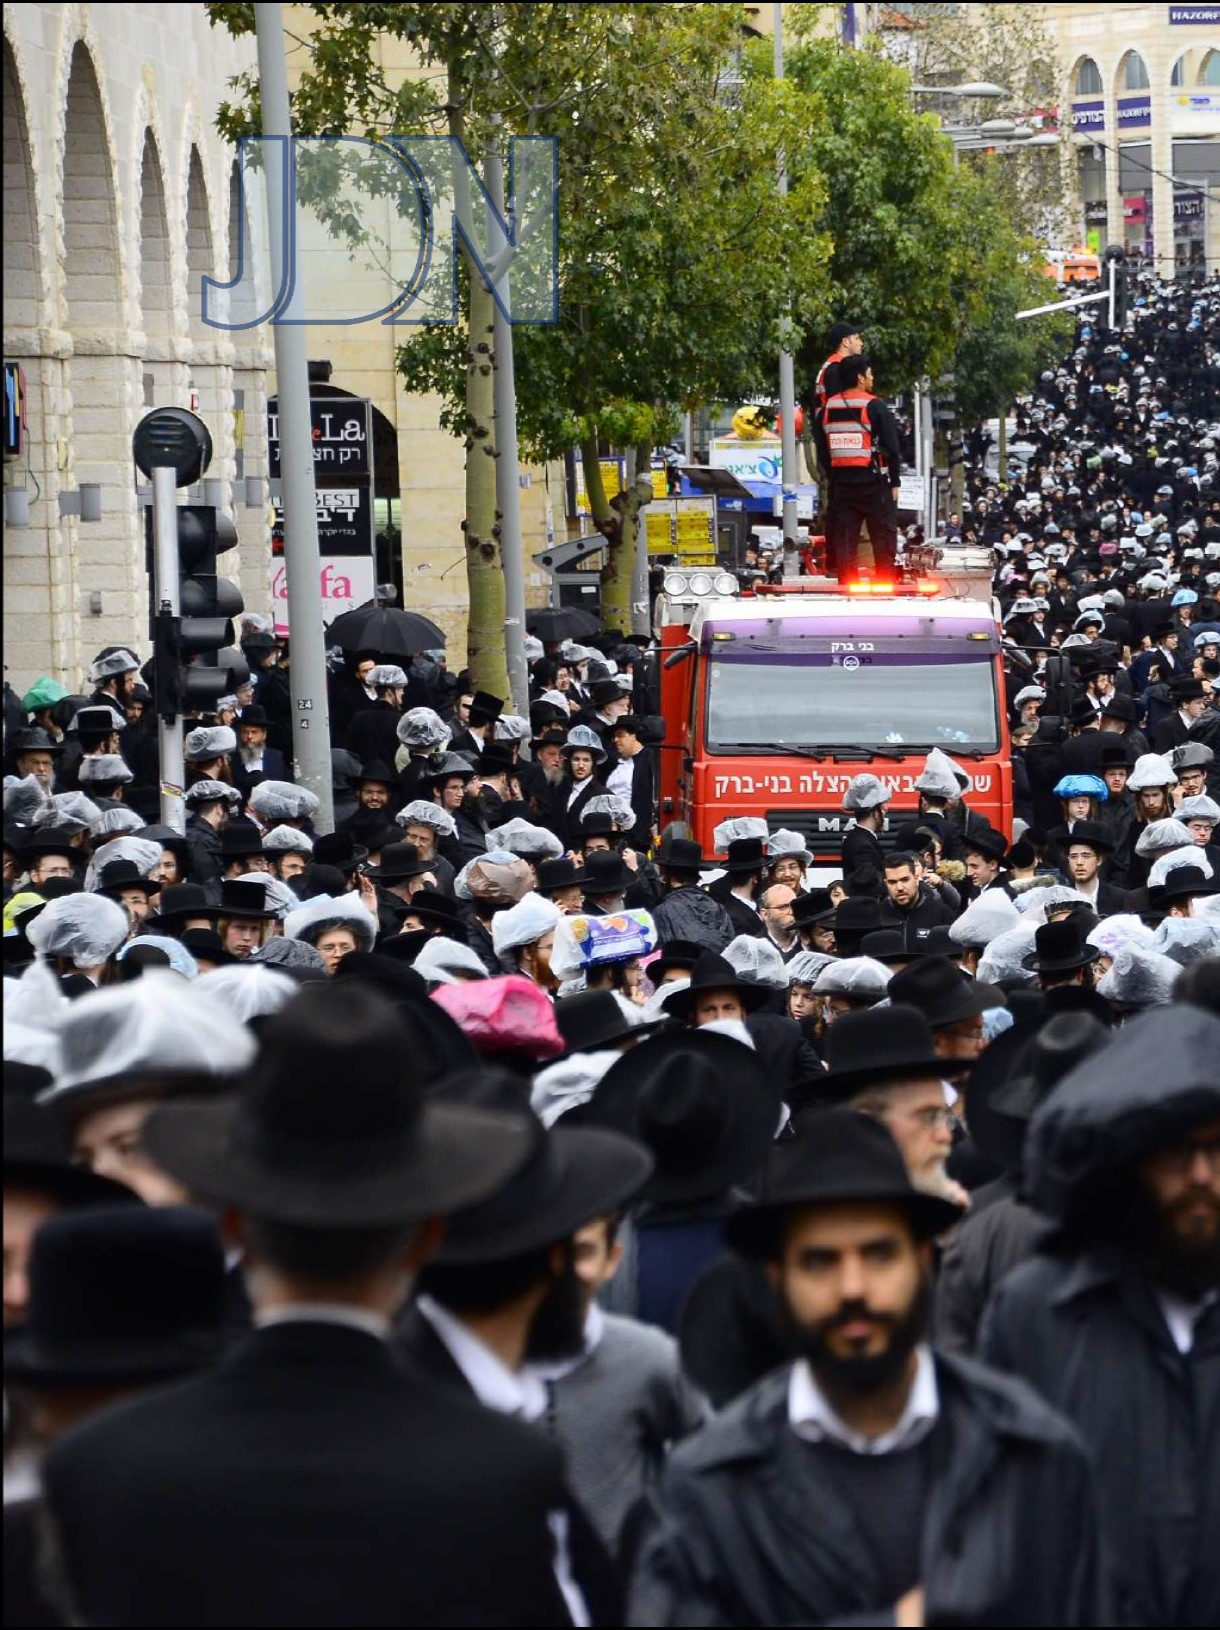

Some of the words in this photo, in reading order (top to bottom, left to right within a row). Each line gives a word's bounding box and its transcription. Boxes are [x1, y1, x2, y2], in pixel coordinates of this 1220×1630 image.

[338, 447, 361, 464] רק
[831, 642, 855, 654] ברק
[858, 642, 875, 651] בני
[299, 700, 311, 709] 24
[800, 770, 852, 793] הצלה
